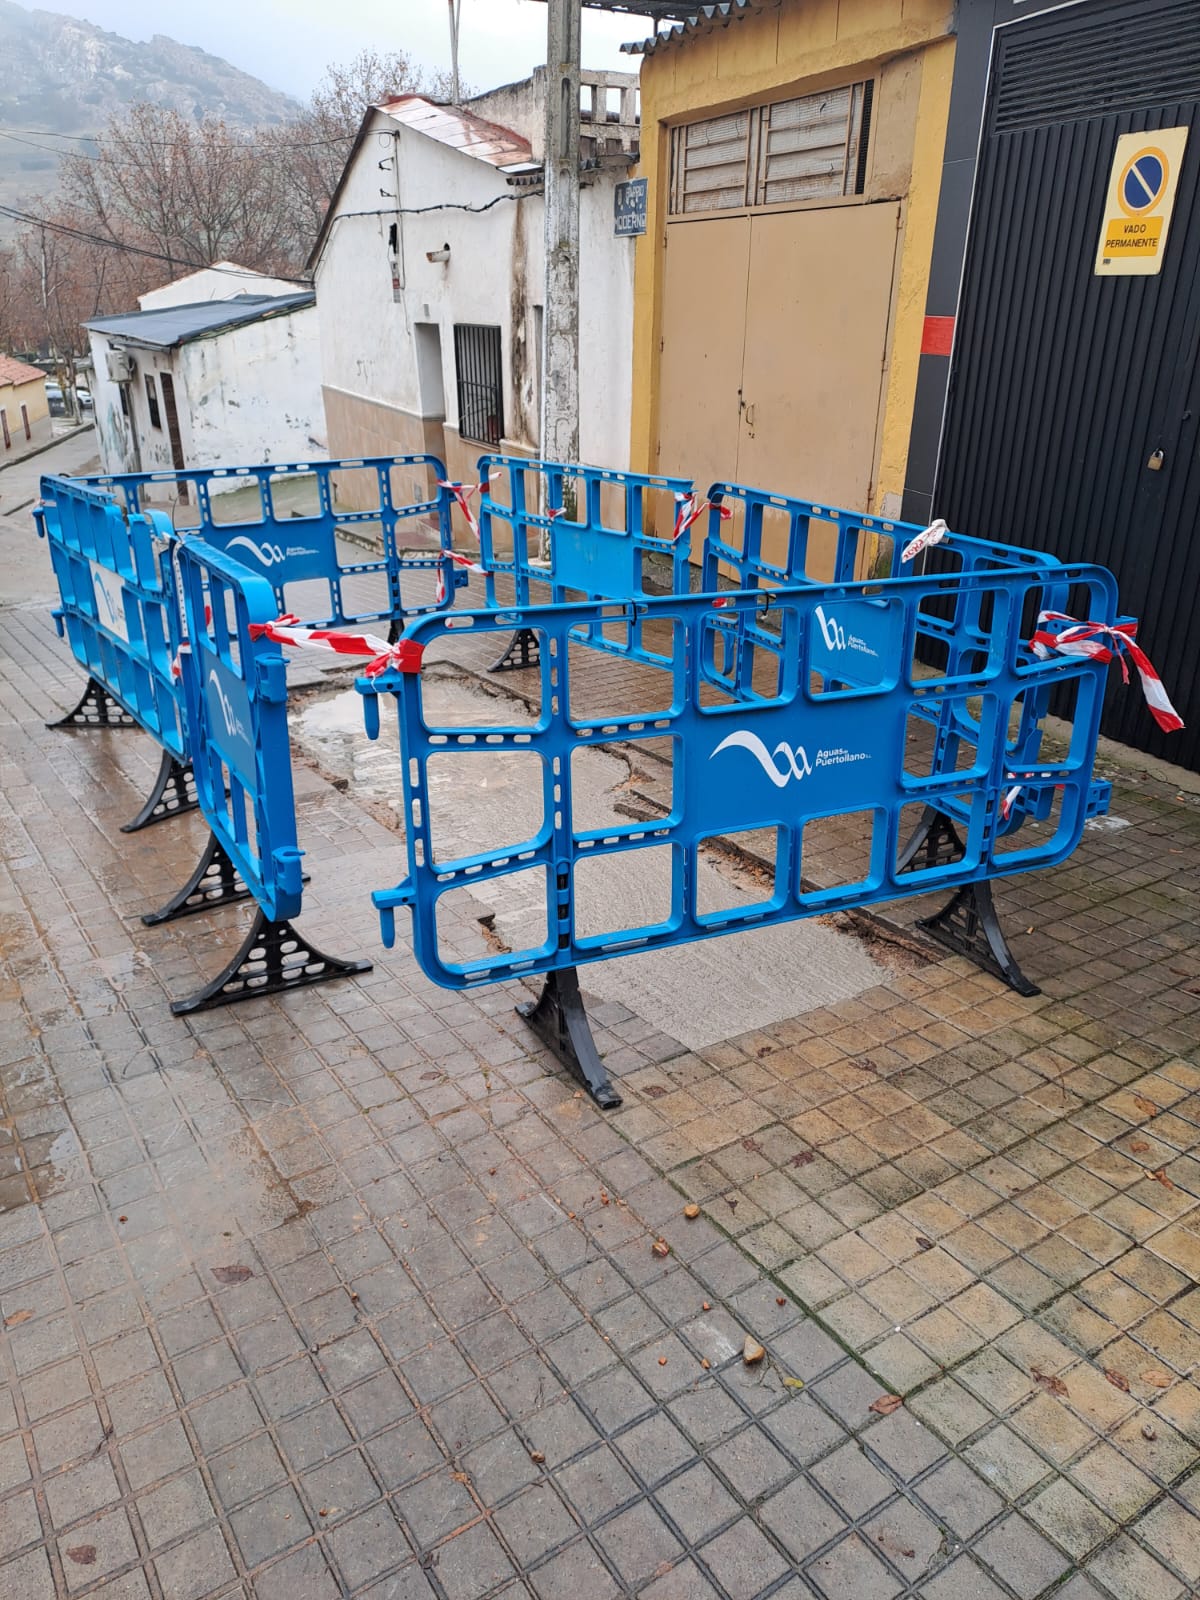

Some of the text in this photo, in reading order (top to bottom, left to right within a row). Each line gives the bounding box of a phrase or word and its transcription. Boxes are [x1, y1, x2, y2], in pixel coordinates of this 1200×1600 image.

[614, 213, 647, 230] MODERNO
[1123, 224, 1147, 234] VADO
[1105, 238, 1158, 248] PERMANENTE
[816, 748, 843, 759] Aguas
[815, 753, 866, 767] Puertollano
